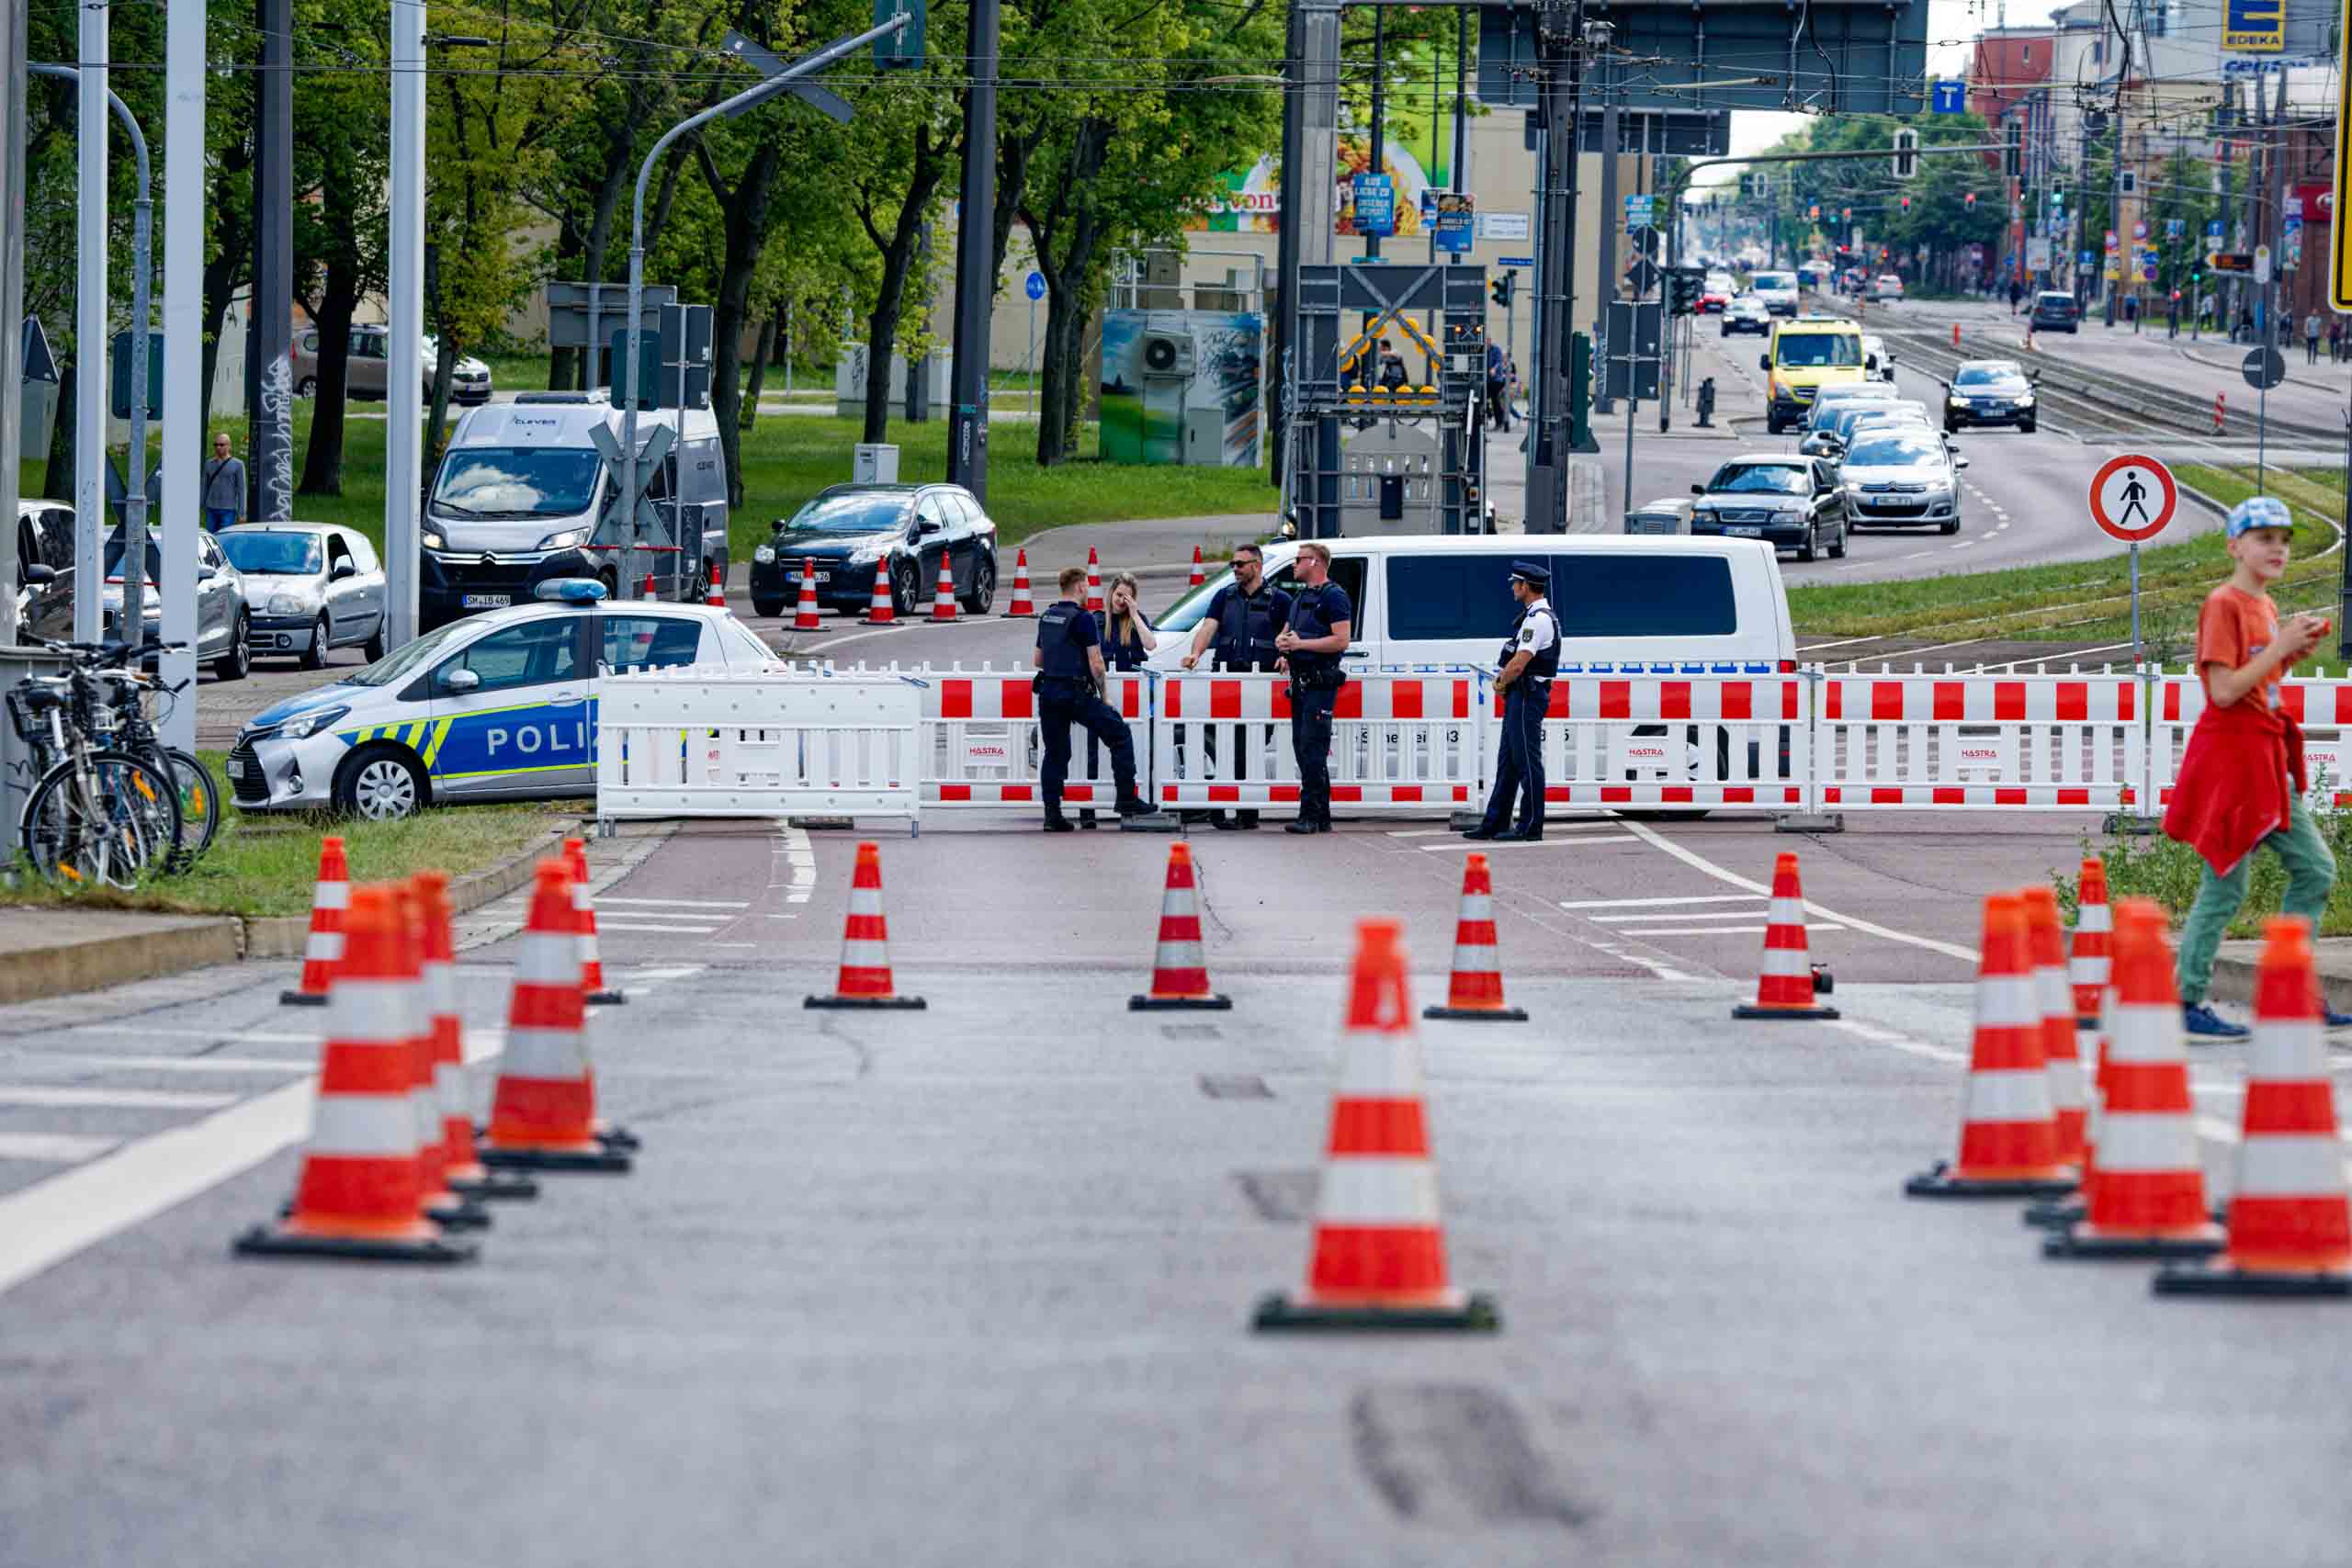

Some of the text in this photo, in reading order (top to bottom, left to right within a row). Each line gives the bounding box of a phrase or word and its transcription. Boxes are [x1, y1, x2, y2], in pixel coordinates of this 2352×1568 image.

[2227, 36, 2279, 45] EDEKA
[969, 747, 1004, 757] HASTRA
[1629, 749, 1664, 758] HASTRA
[1962, 749, 1997, 758] HASTRA
[2304, 753, 2336, 762] ASTRA
